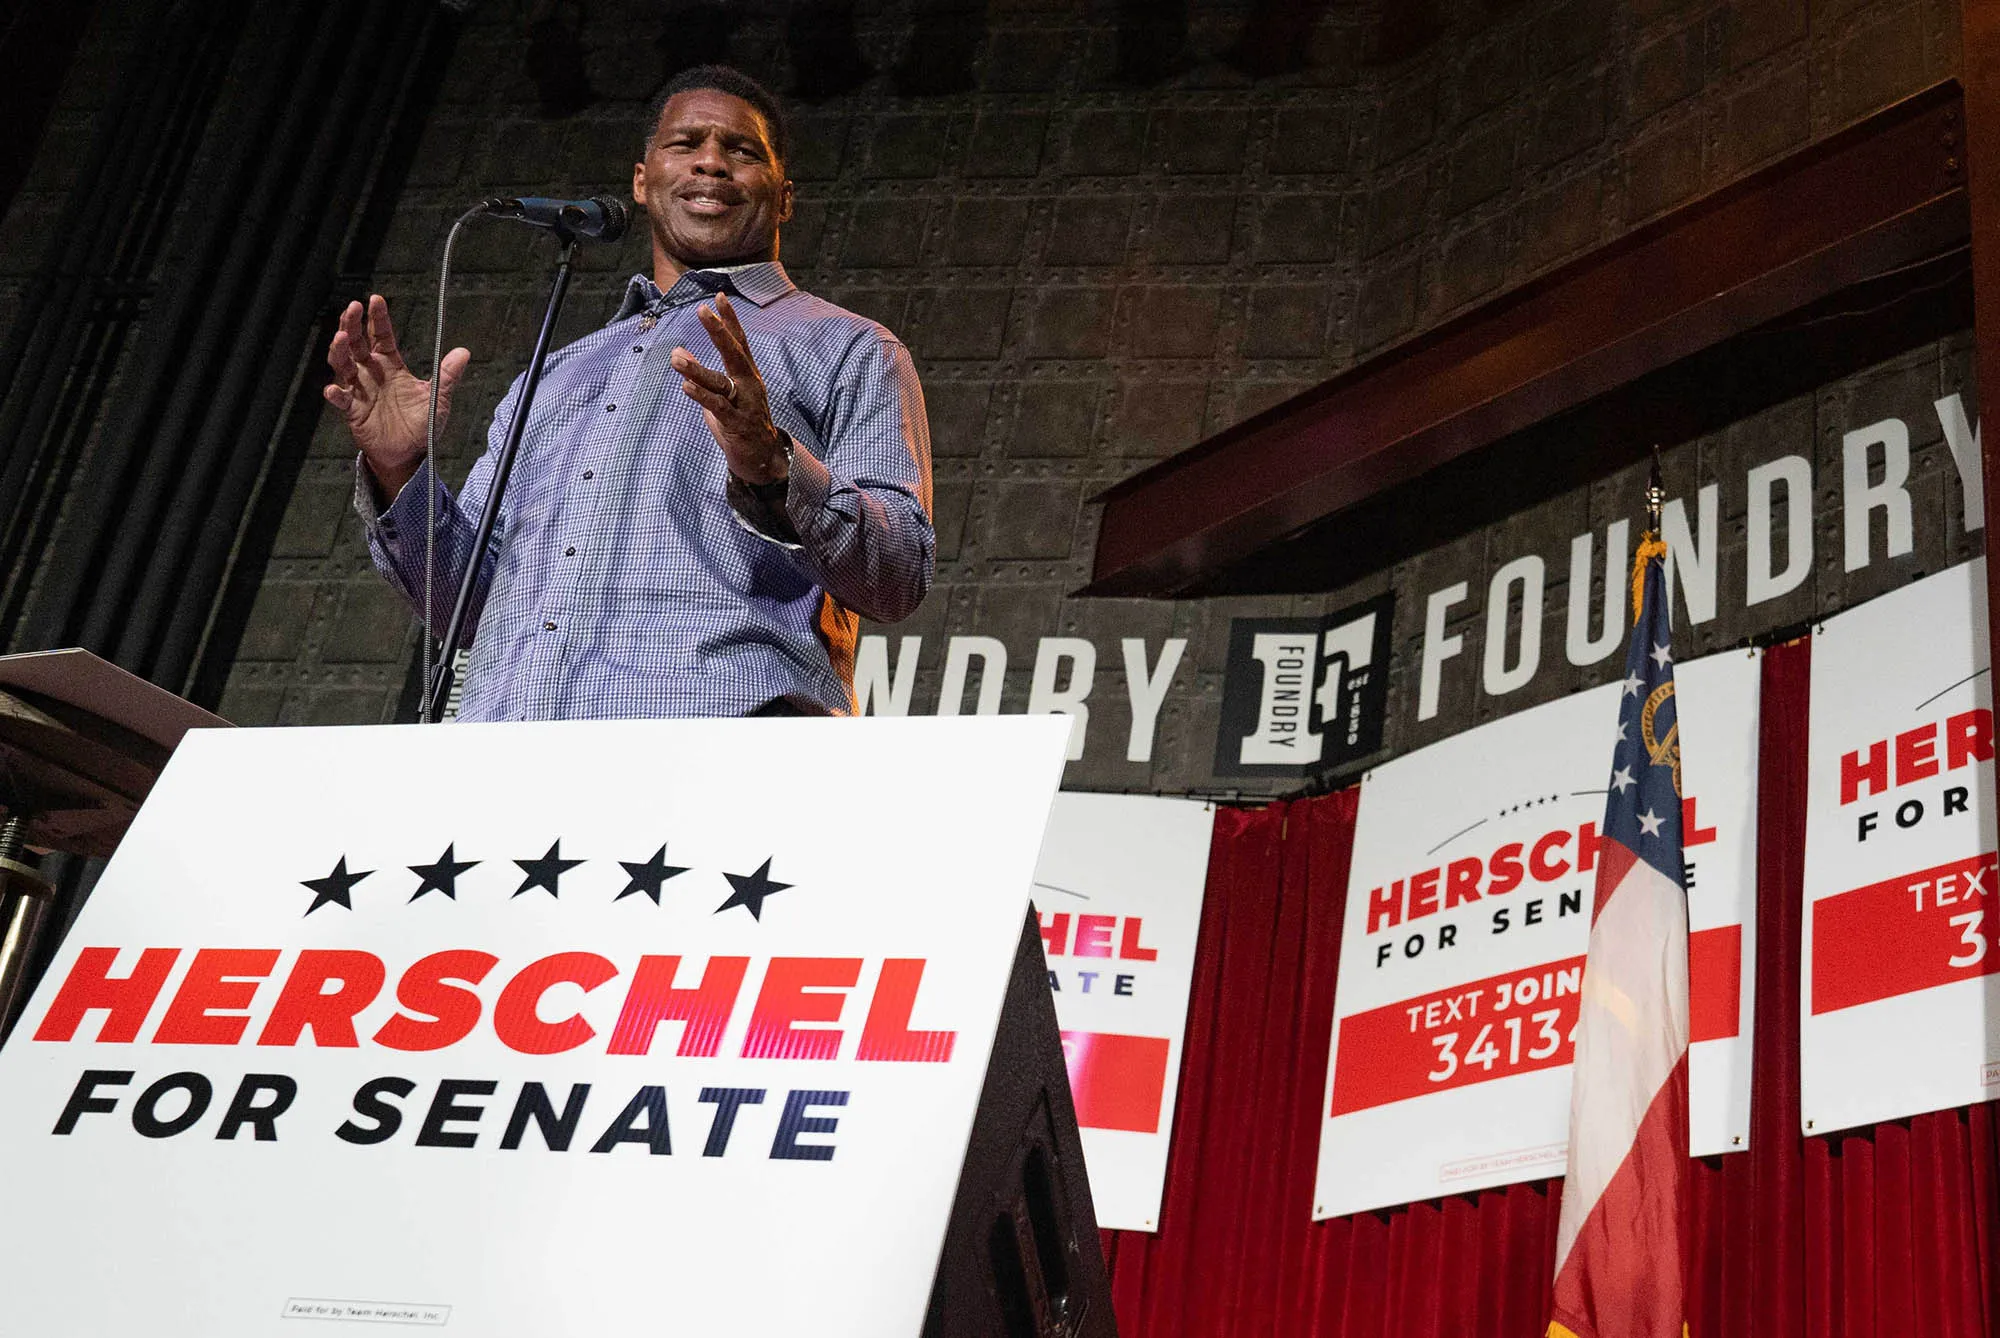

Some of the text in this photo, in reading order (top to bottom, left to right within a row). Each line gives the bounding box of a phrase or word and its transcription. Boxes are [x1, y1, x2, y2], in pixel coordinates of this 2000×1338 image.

[1418, 392, 1985, 722] FOUNDRY
[853, 634, 1188, 763] NDRY
[1268, 645, 1305, 749] FOUNDRY
[1858, 786, 1969, 842] FOR
[1376, 924, 1457, 968] FOR
[32, 946, 959, 1063] HERSCHEL
[1407, 967, 1582, 1033] TEXT JOIN
[1428, 1008, 1579, 1081] 3413
[51, 1069, 850, 1161] FOR SENATE
